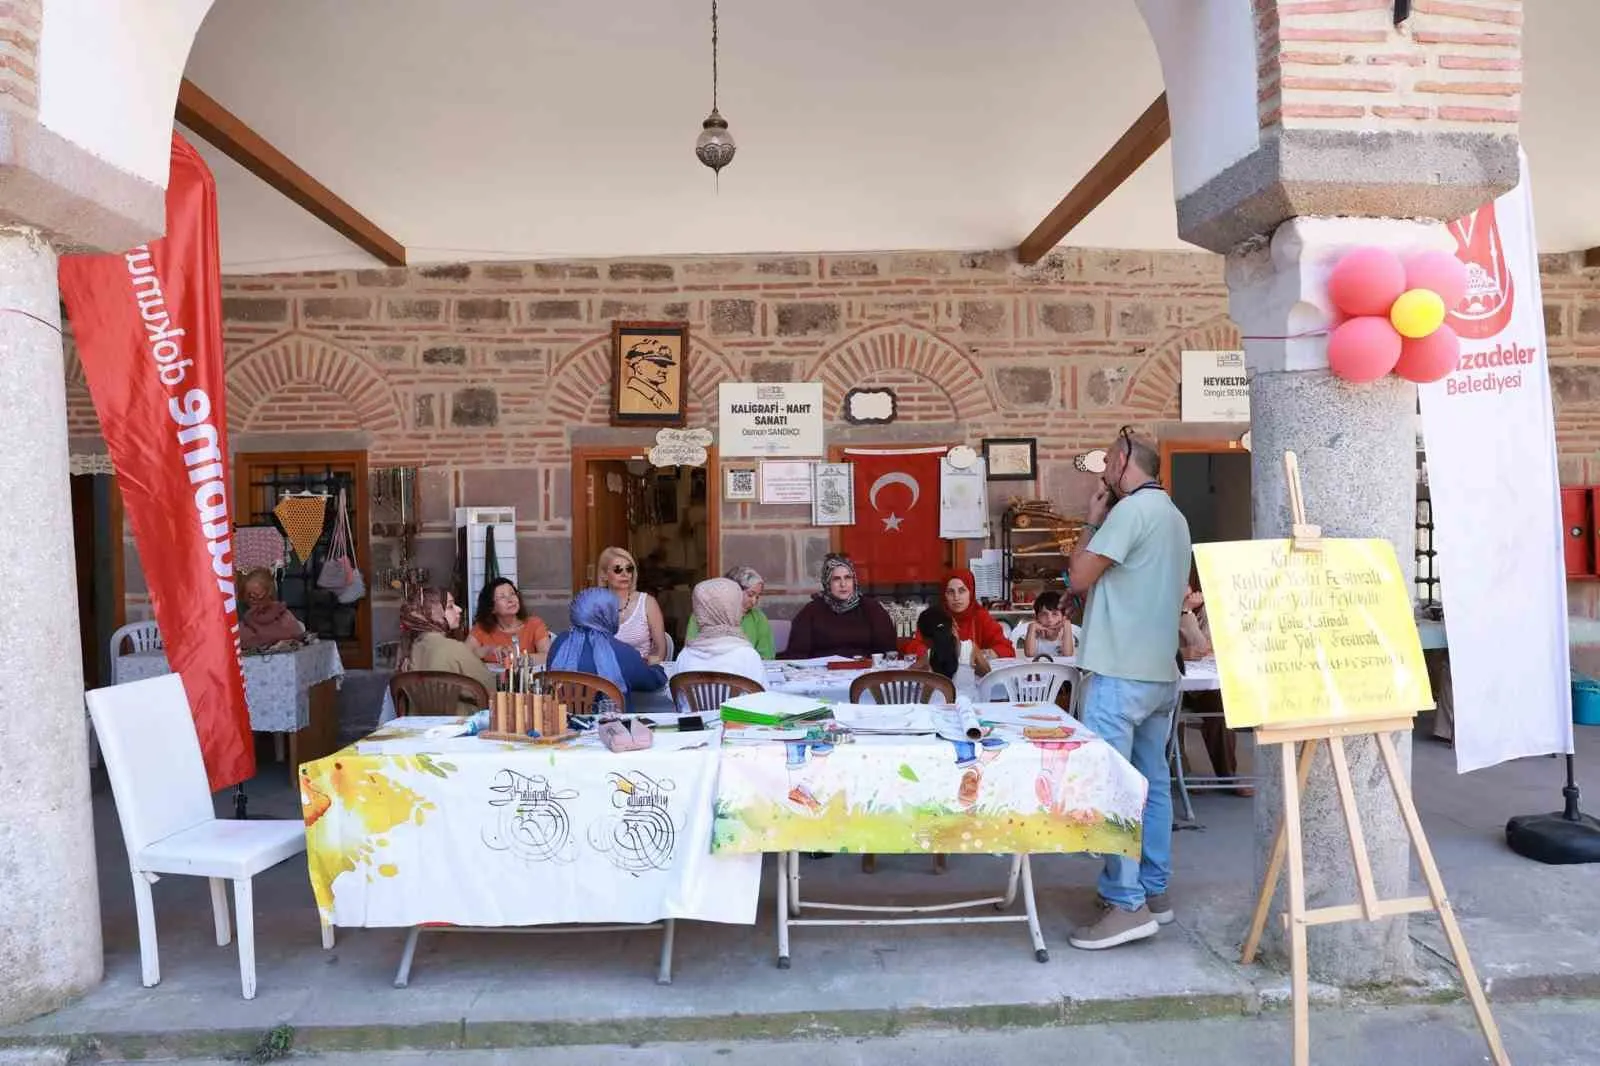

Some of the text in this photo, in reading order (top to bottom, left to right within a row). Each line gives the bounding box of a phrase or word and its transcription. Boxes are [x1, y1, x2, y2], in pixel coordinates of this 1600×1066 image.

[1456, 342, 1536, 372] zadeler
[1446, 370, 1522, 396] Belediyesi
[731, 401, 779, 413] KALİGRAFİ
[786, 404, 811, 413] NAHT
[754, 415, 787, 425] SANATI
[742, 428, 767, 436] Osman
